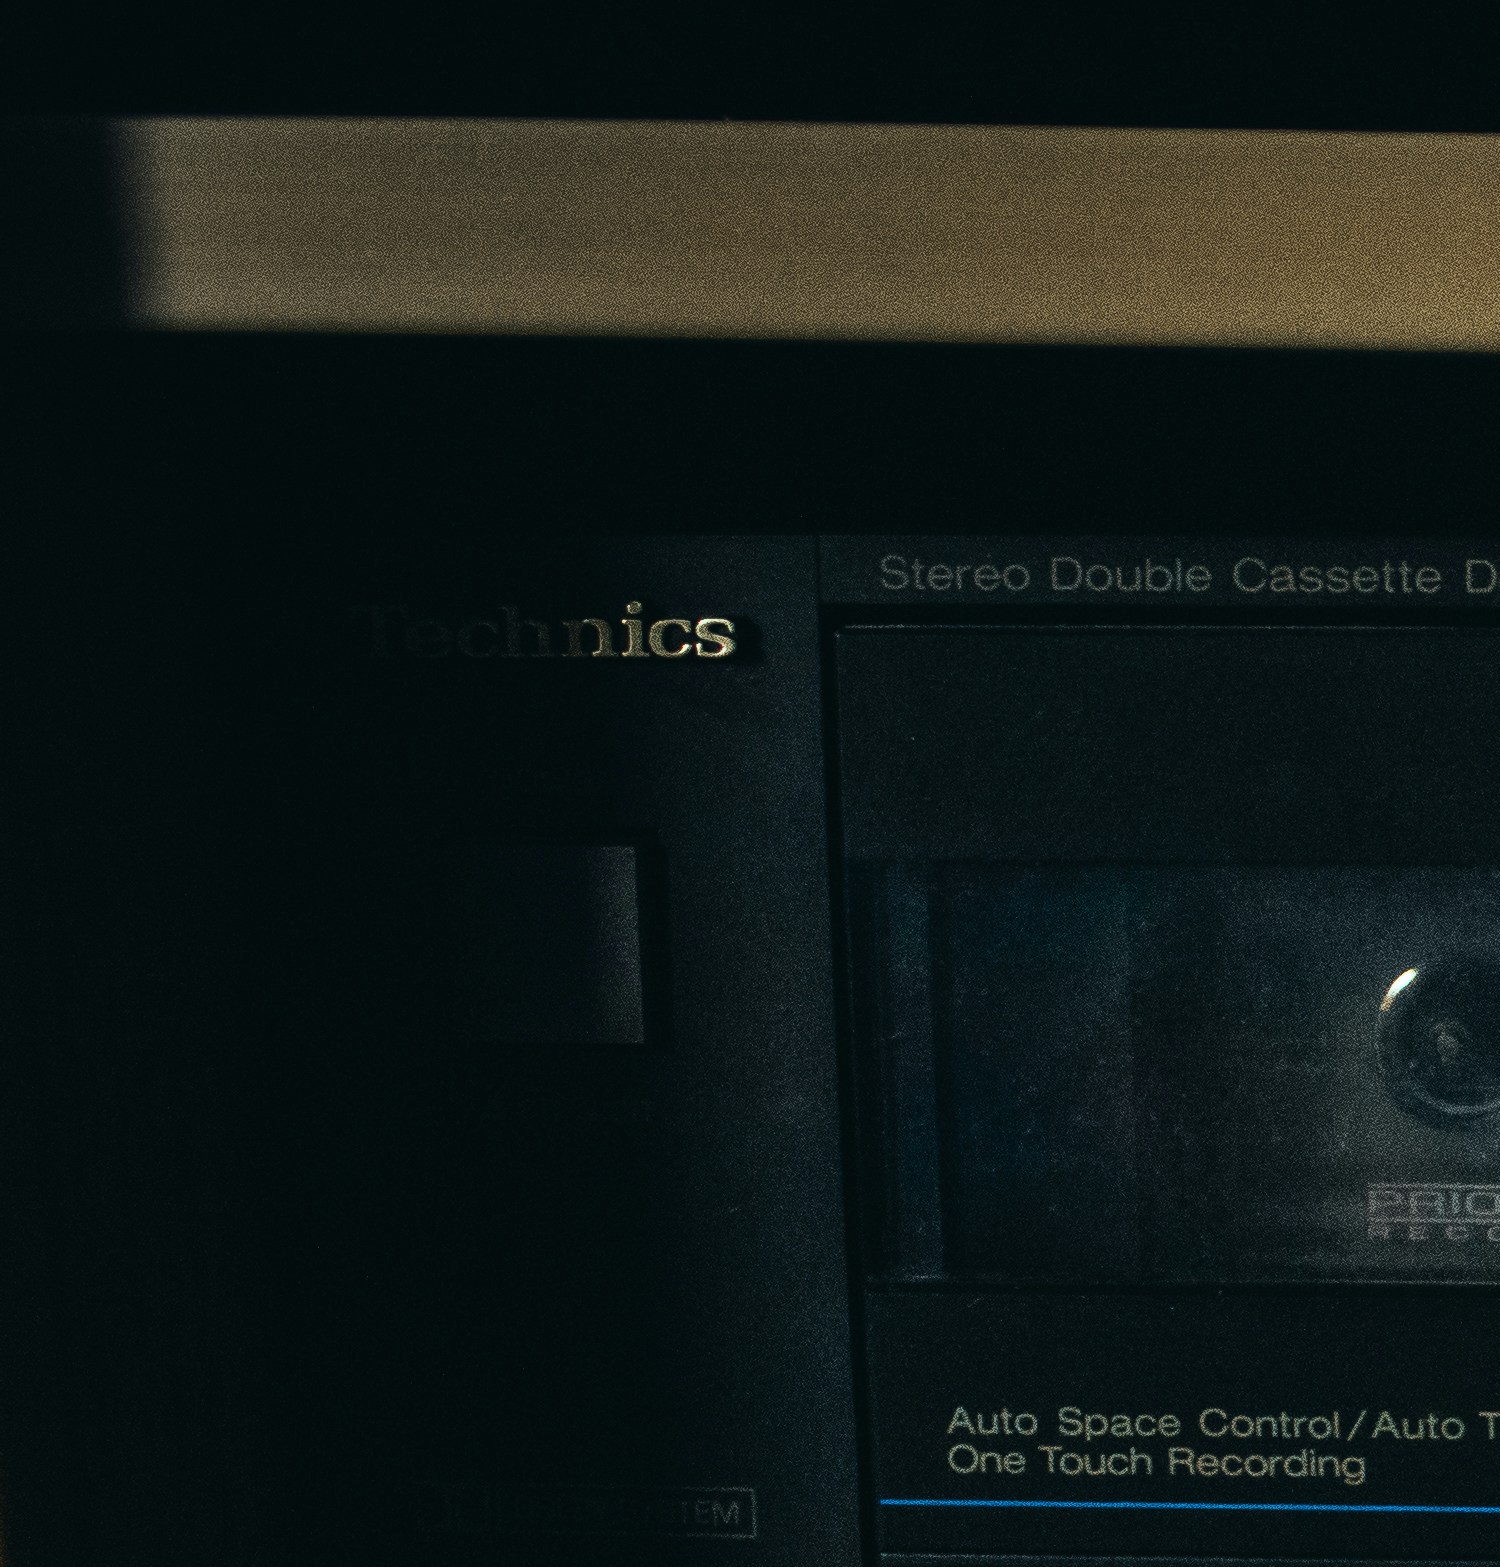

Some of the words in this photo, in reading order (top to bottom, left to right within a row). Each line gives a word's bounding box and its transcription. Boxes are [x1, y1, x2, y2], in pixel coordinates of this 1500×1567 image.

[881, 554, 1031, 591] Stereo
[1050, 556, 1212, 592] Double
[1233, 557, 1442, 594] Cassette
[355, 600, 737, 659] Technics
[948, 1406, 1038, 1435] Auto
[1058, 1406, 1180, 1441] Space
[1199, 1408, 1465, 1440] Control/Auto
[948, 1444, 1025, 1474] One
[1039, 1445, 1152, 1476] Touch
[1168, 1447, 1366, 1485] Recording
